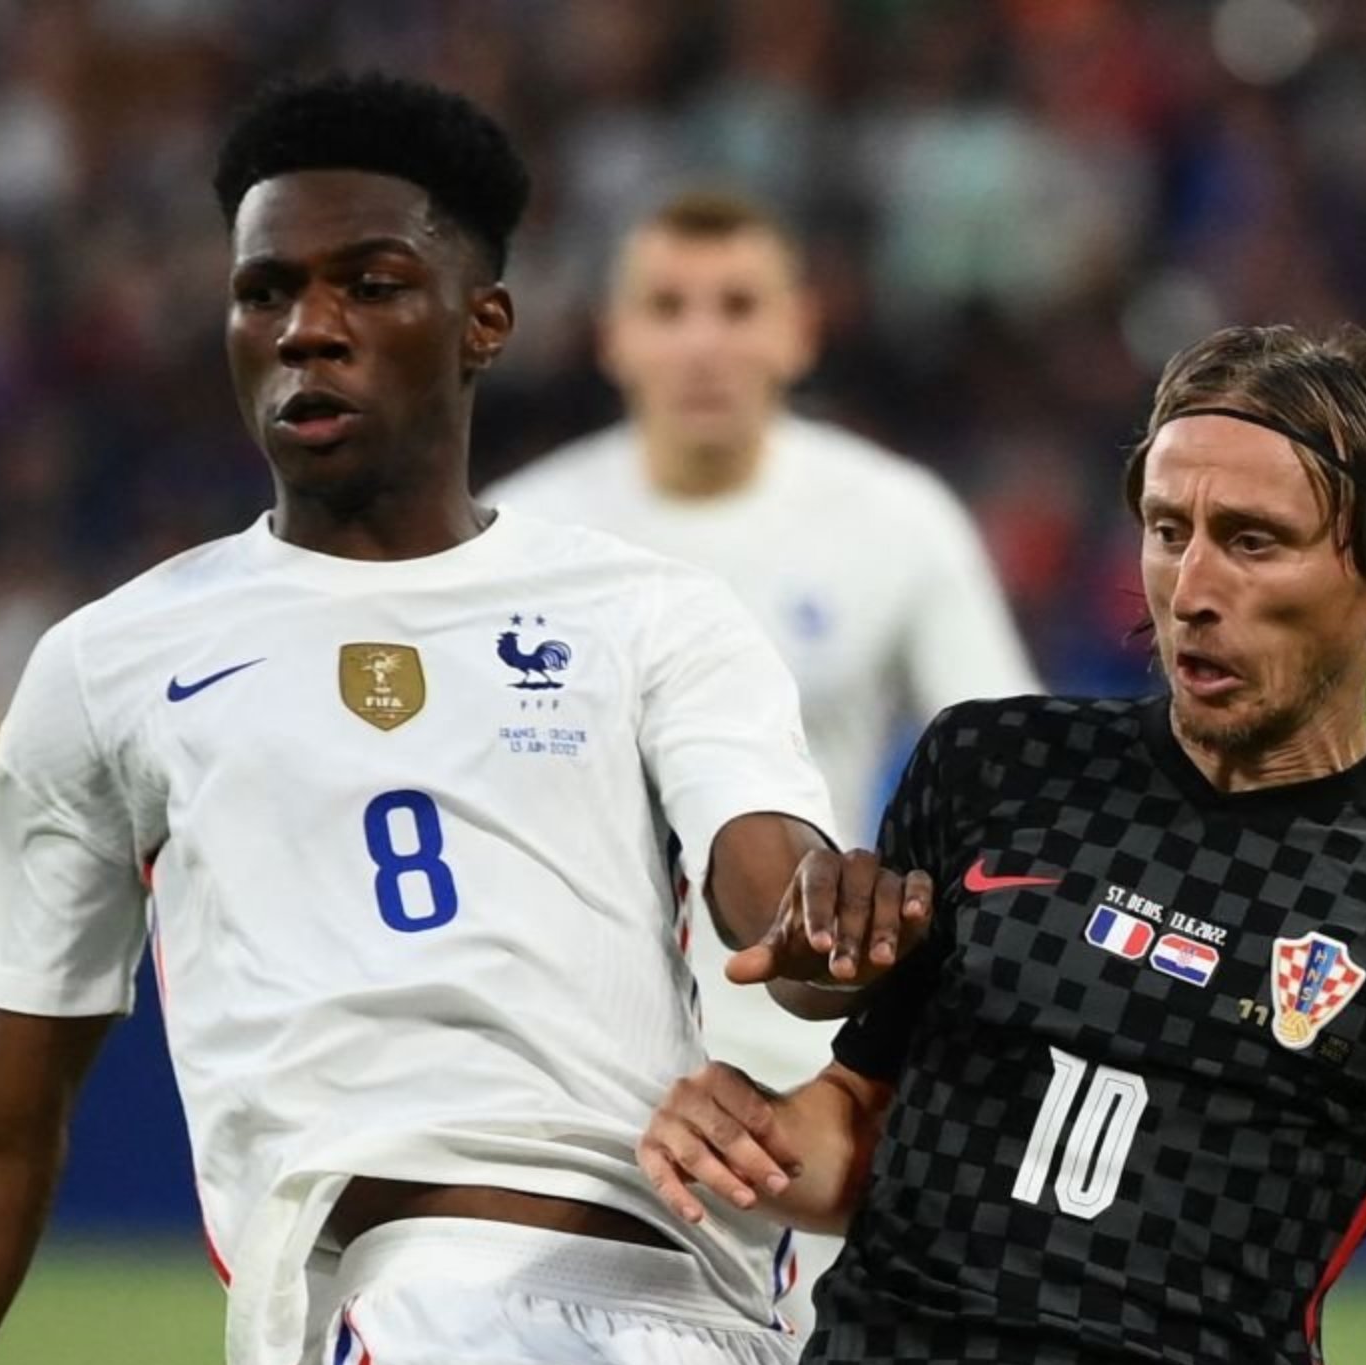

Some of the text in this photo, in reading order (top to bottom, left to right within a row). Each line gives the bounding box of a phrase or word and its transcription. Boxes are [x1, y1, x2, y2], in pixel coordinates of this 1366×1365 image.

[365, 696, 404, 707] FIFA
[363, 789, 458, 933] 8
[1106, 885, 1126, 906] ST.
[1300, 948, 1328, 1001] HNS
[1011, 1045, 1149, 1220] 10
